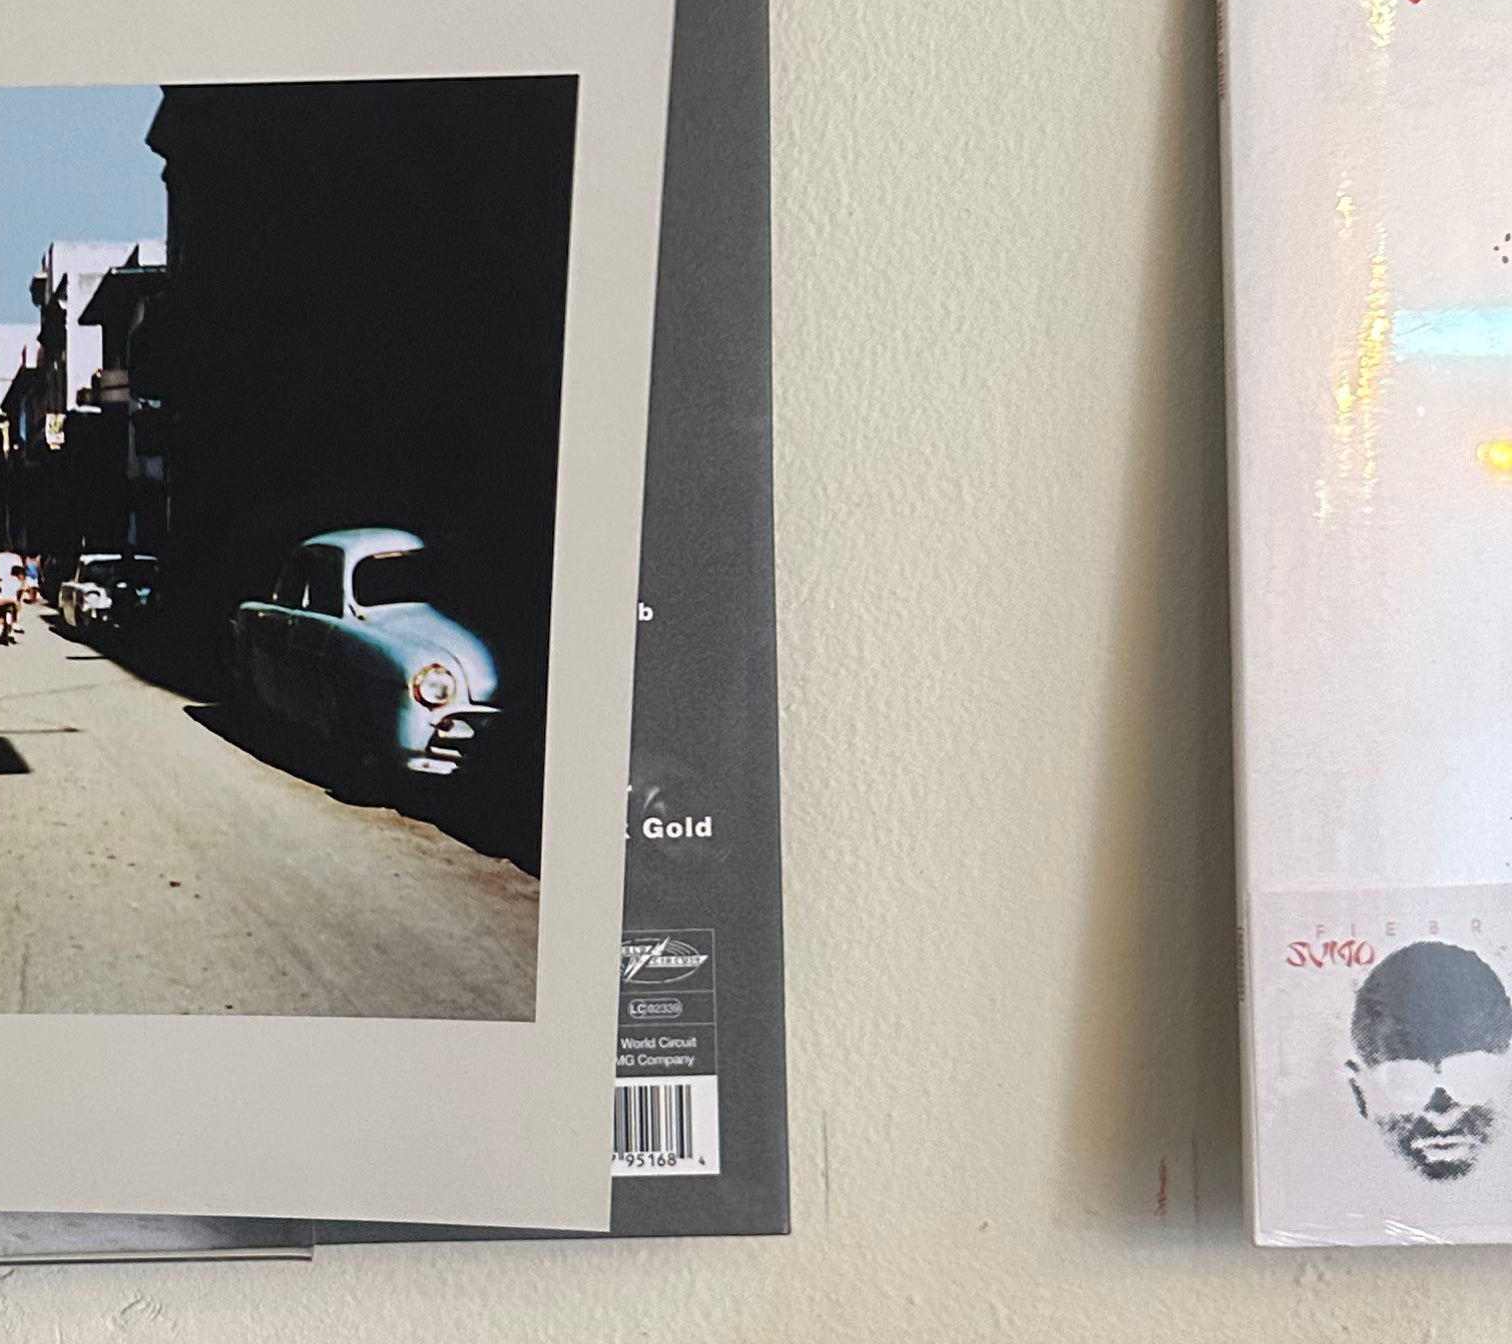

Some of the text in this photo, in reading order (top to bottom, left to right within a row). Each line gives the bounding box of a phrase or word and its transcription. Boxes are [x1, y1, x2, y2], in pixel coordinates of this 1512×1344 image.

[642, 816, 713, 839] Gold
[620, 1037, 697, 1049] World Circuit
[637, 1054, 695, 1067] Company
